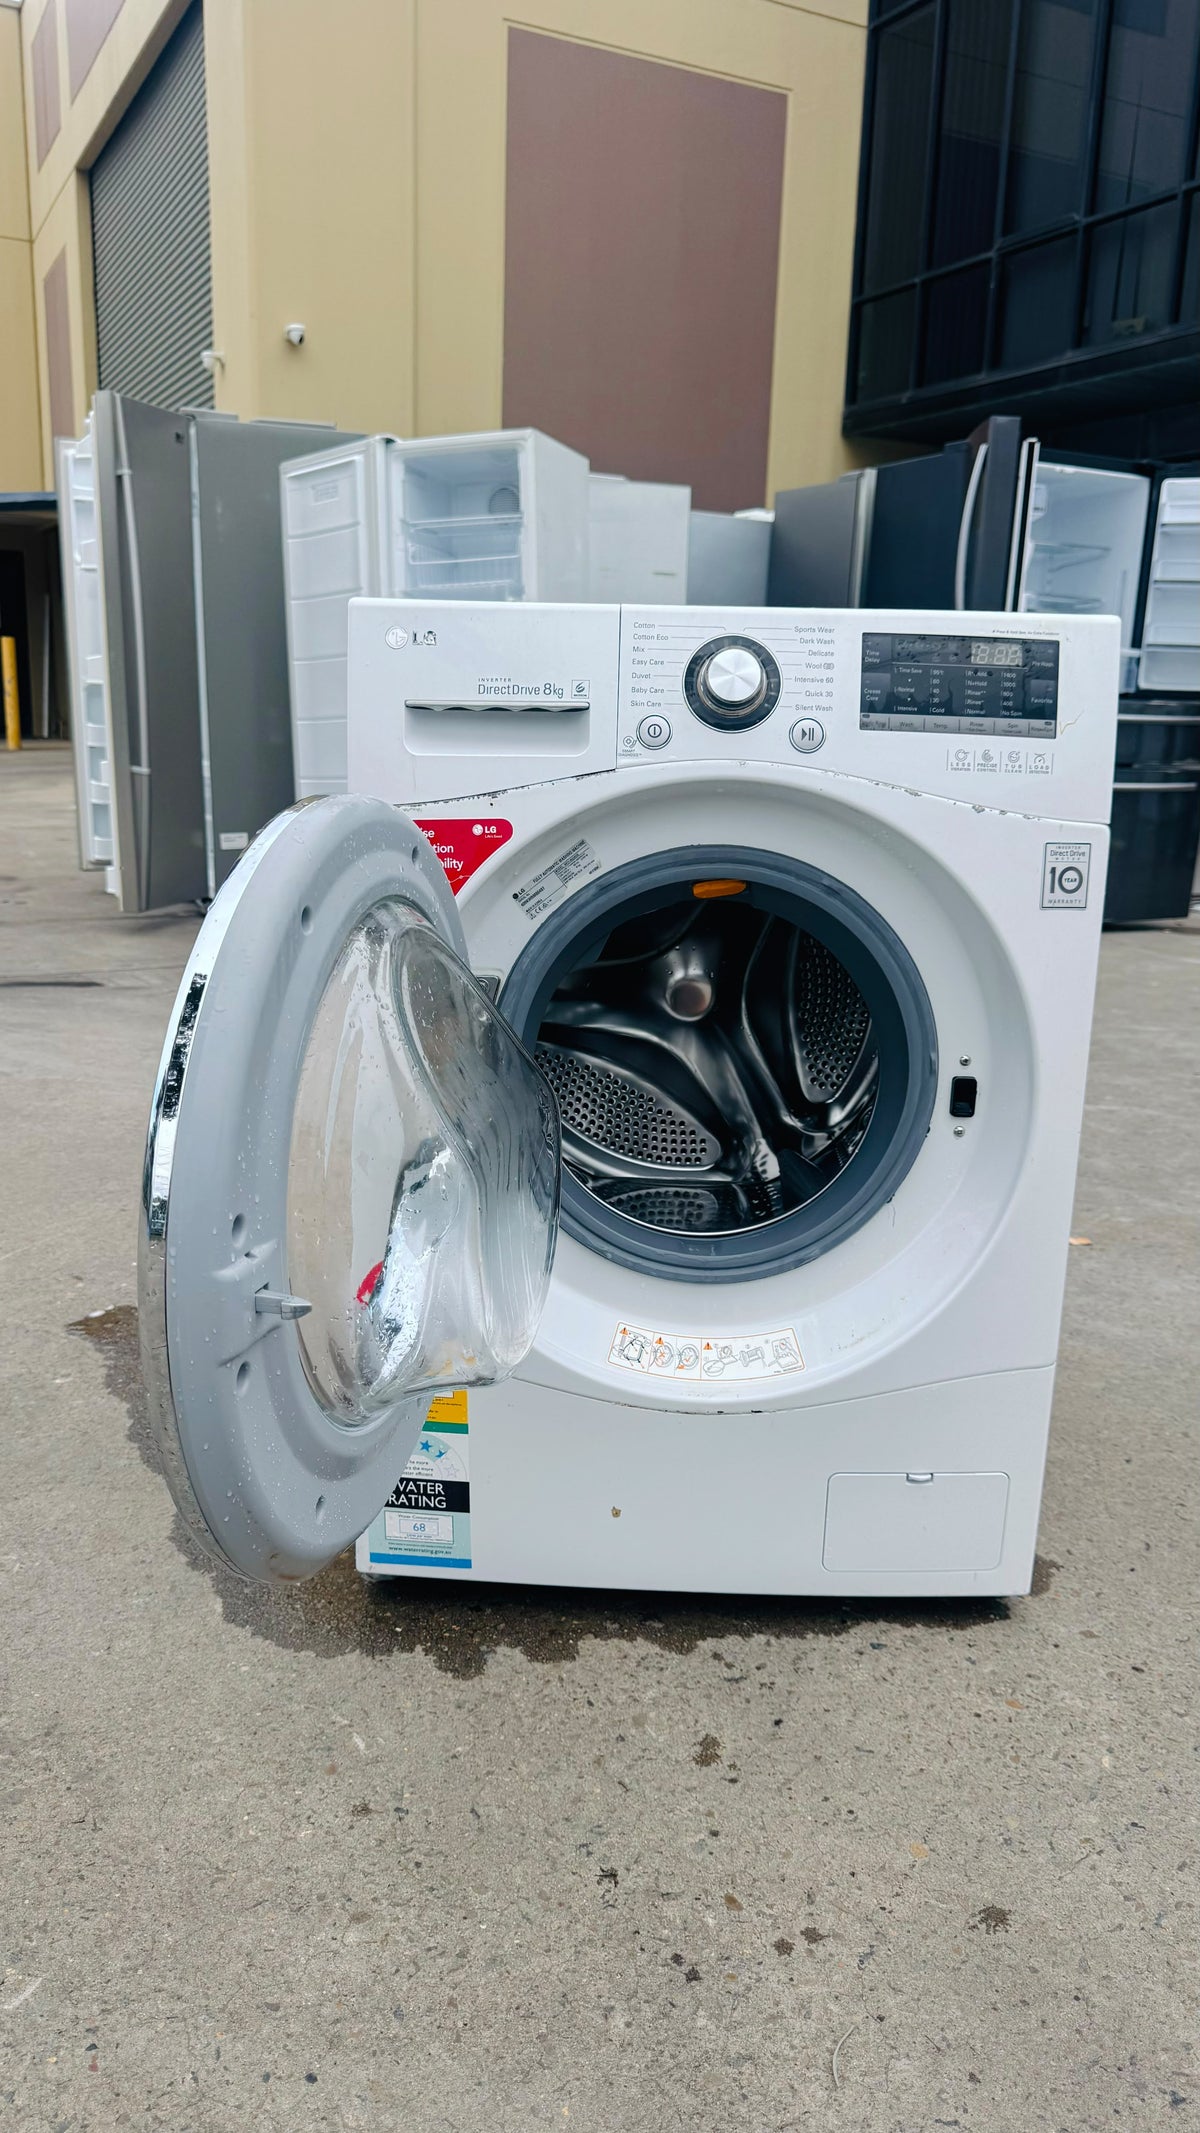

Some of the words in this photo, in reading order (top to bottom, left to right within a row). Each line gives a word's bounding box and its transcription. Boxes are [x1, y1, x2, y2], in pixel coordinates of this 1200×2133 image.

[794, 626, 816, 634] Sports
[817, 626, 835, 634] Wear
[412, 630, 437, 646] LG
[808, 649, 835, 657] Delicate
[631, 686, 648, 694] Baby
[646, 700, 662, 708] Care
[814, 704, 833, 712] Wash
[485, 826, 497, 834] LG
[1049, 866, 1083, 894] 10
[389, 1493, 447, 1509] RATING
[413, 1523, 426, 1532] 68
